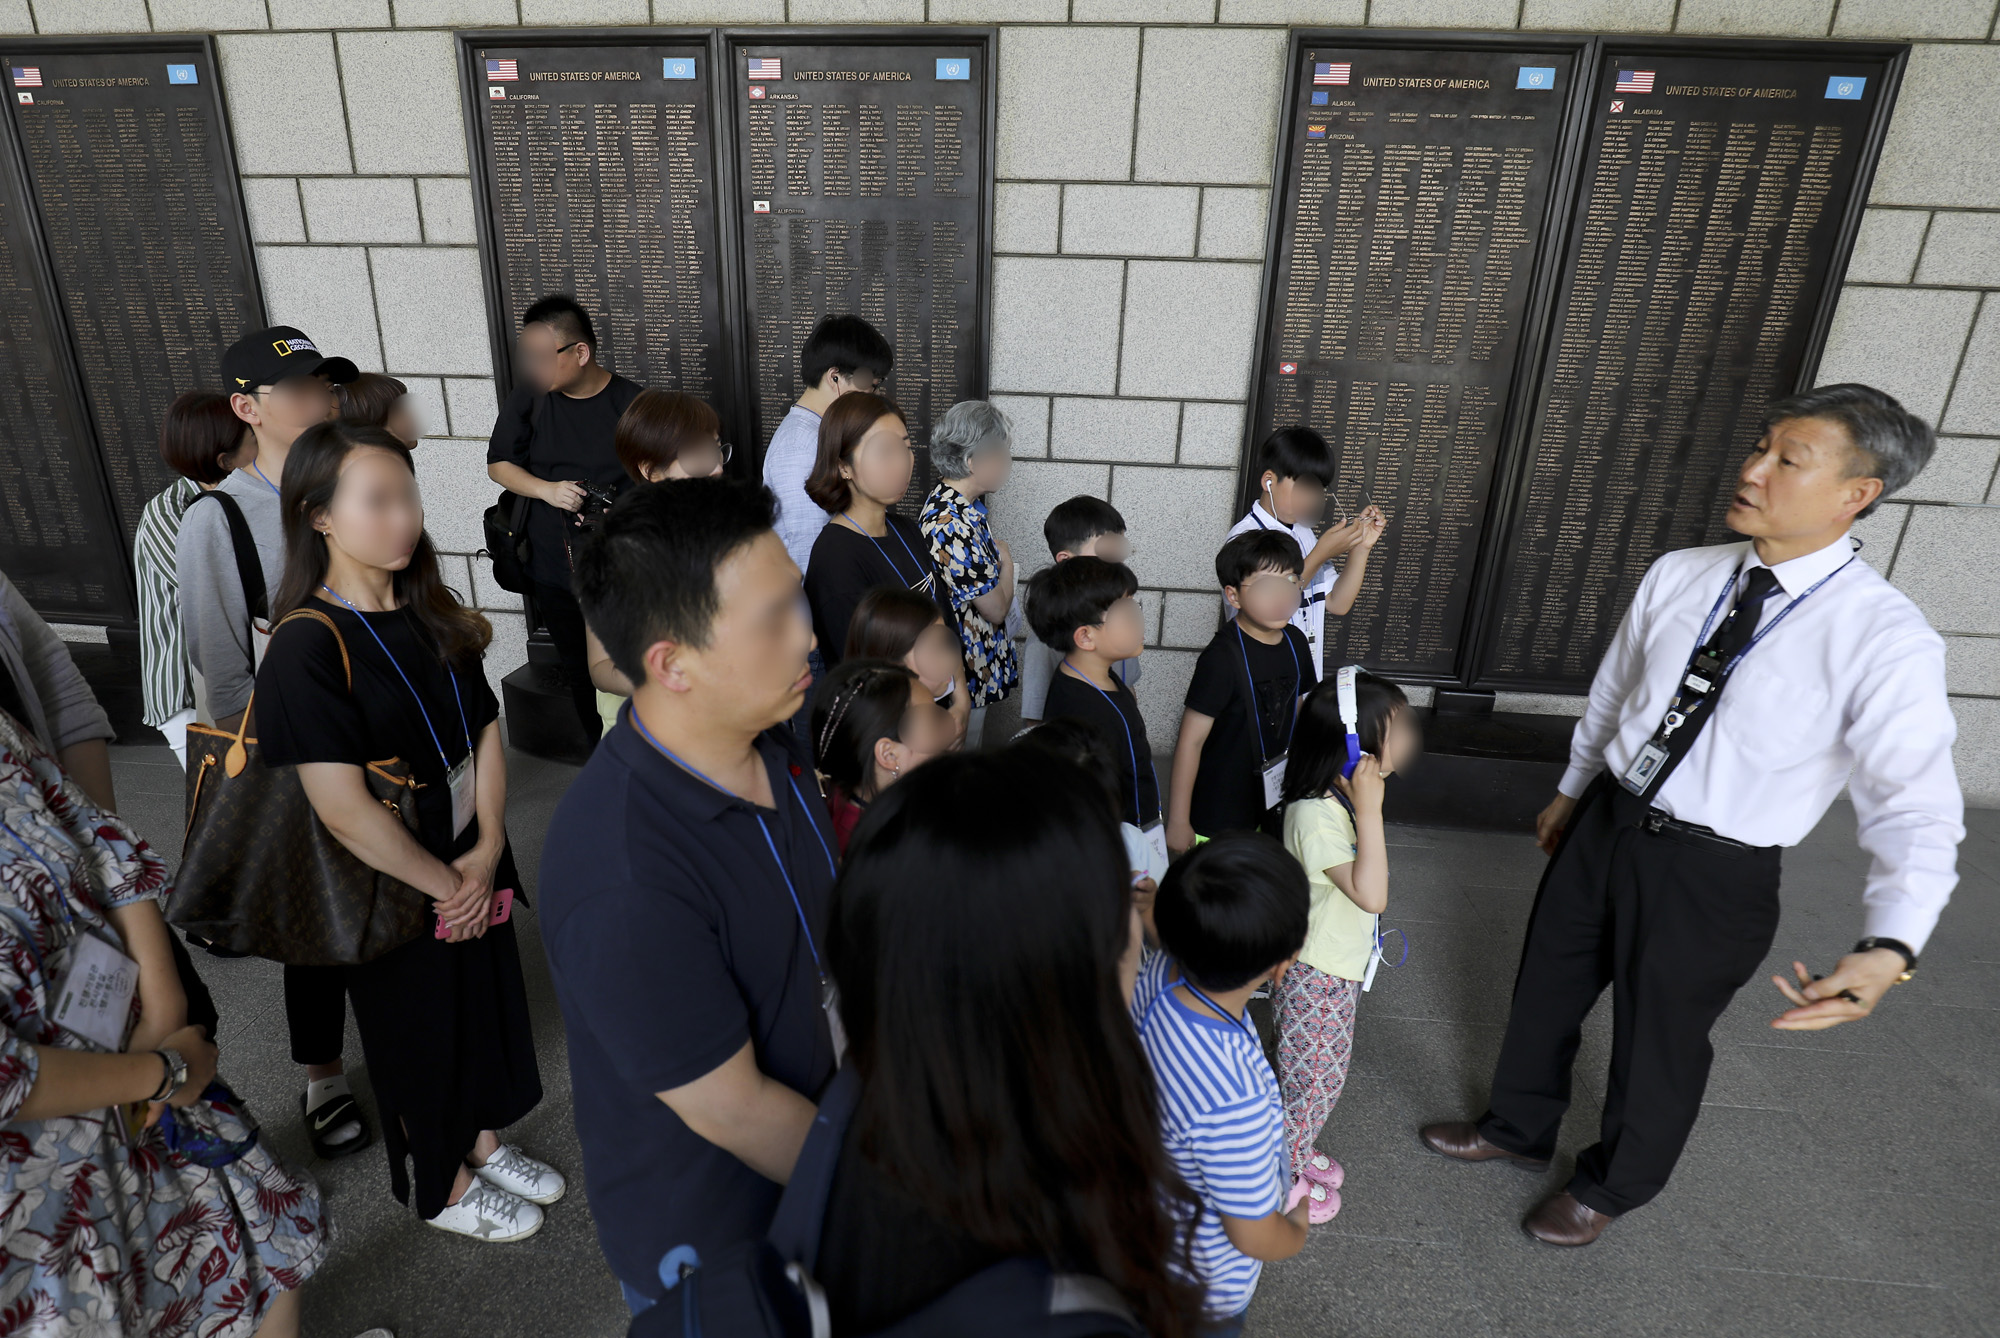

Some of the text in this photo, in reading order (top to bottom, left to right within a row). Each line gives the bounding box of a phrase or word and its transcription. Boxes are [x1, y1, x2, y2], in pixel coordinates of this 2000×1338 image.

[480, 50, 486, 58] 4
[742, 48, 748, 57] 3
[1309, 52, 1315, 61] 2
[529, 71, 641, 82] UNITED STATES OF AMERICA
[793, 72, 912, 81] UNITED STATES OF AMERICA
[52, 78, 150, 88] UNITED STATES OF AMERICA
[1362, 77, 1490, 90] UNITED STATES OF AMERICA
[1665, 85, 1797, 99] UNITED STATES OF AMERICA
